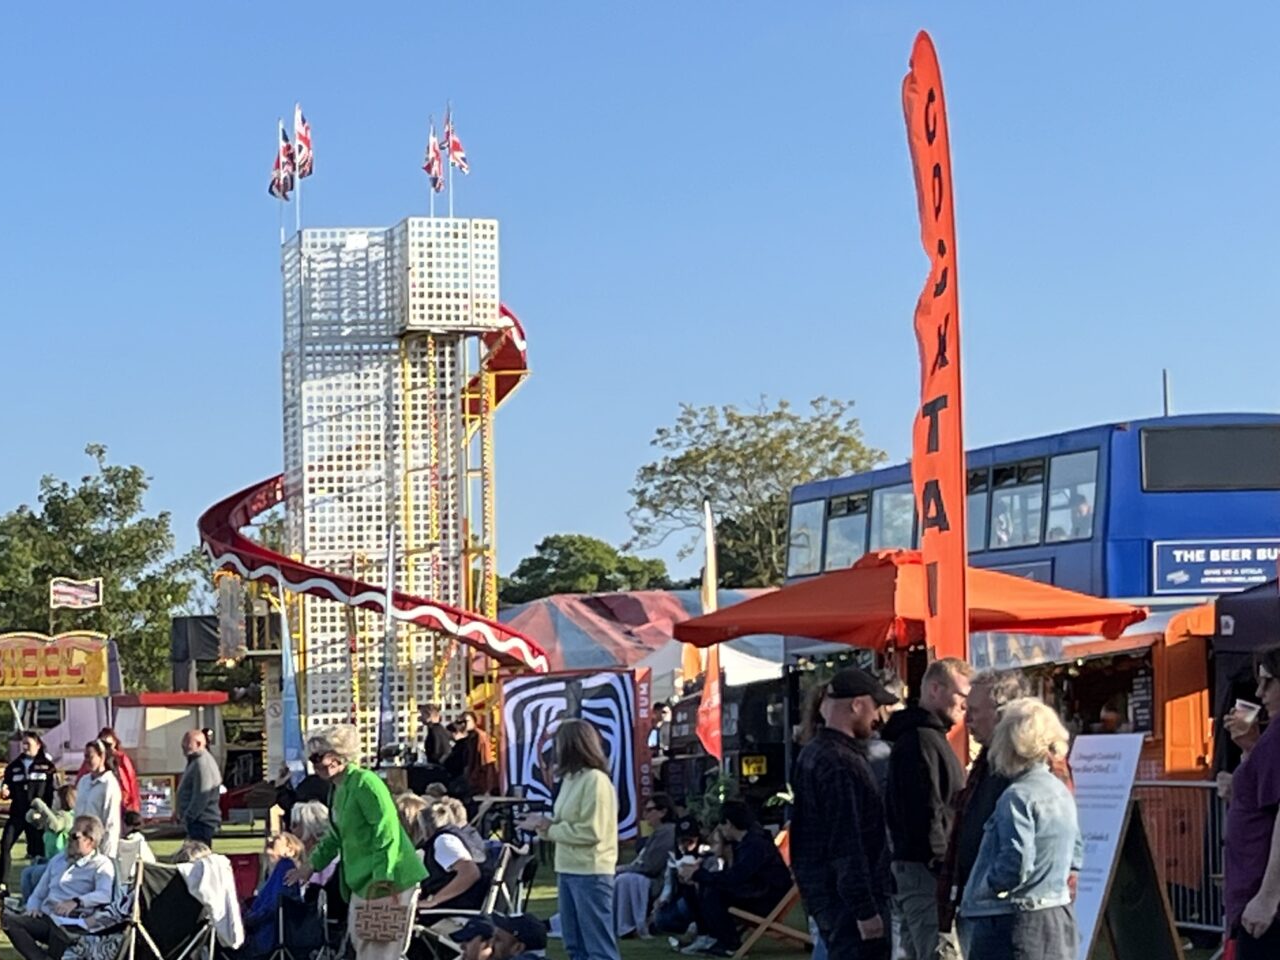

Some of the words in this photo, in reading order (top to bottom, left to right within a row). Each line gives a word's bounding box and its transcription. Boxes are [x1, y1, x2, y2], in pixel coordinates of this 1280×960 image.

[1173, 549, 1206, 562] THE
[1210, 548, 1252, 562] BEER
[1256, 547, 1280, 561] BU
[639, 682, 649, 718] RUM
